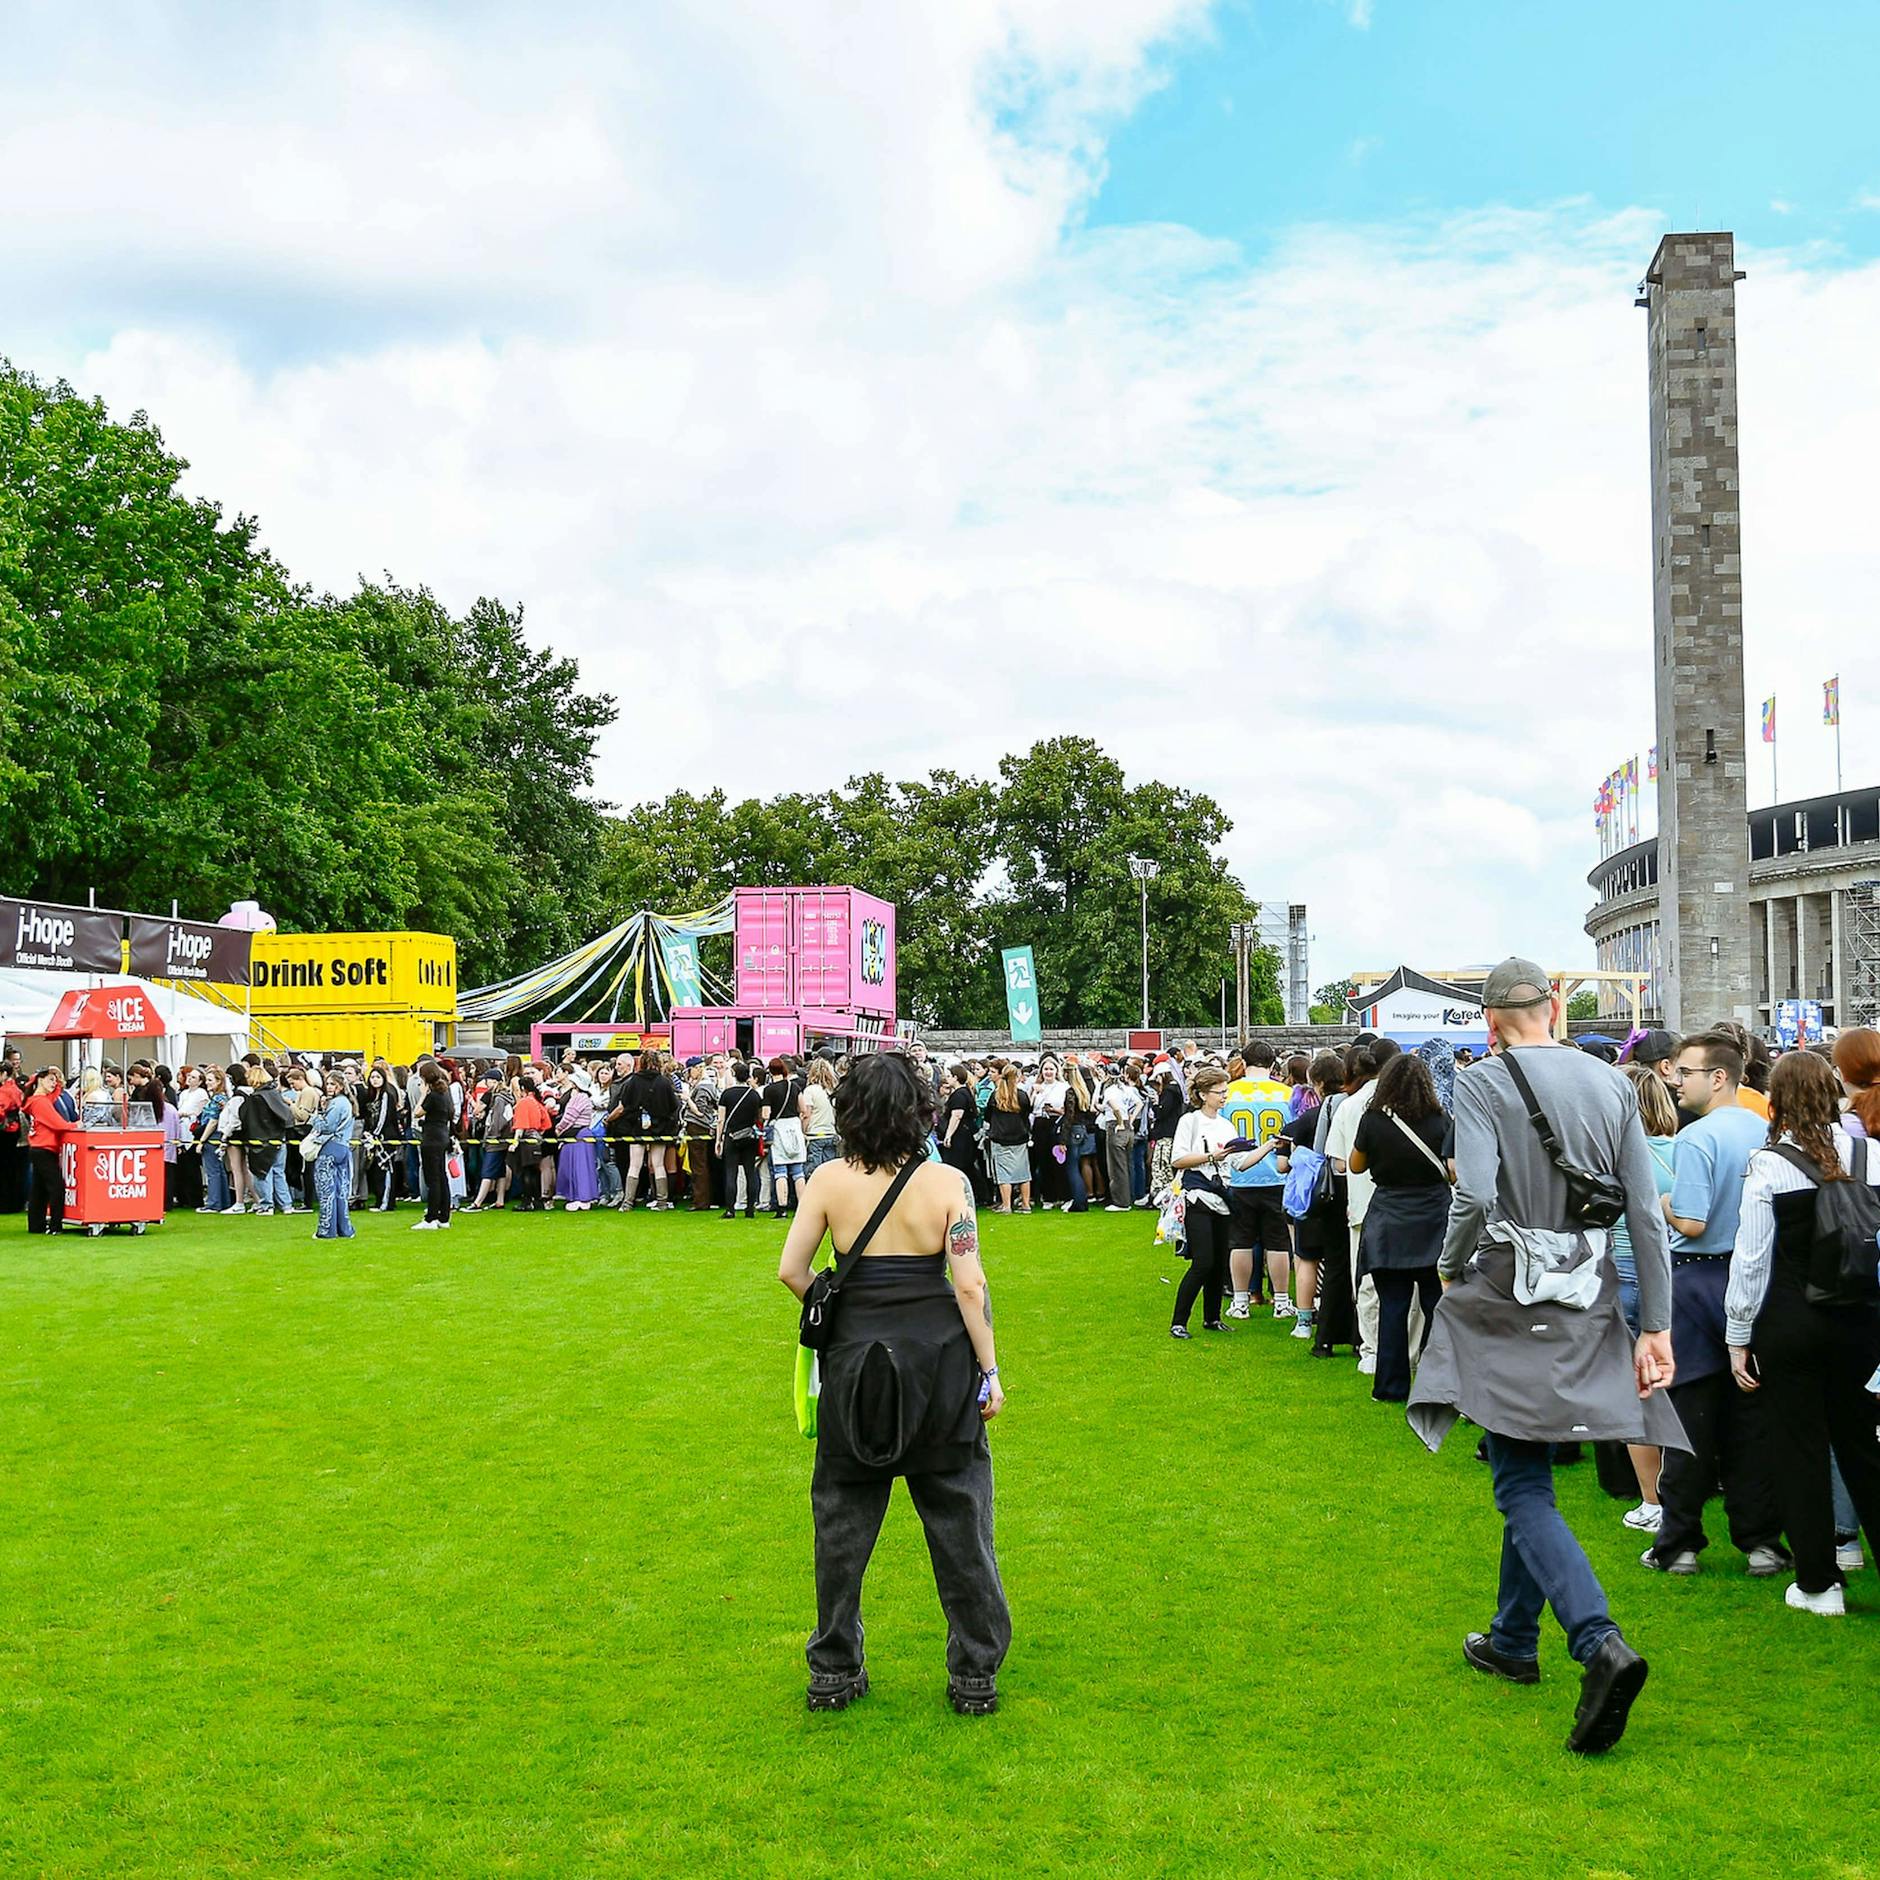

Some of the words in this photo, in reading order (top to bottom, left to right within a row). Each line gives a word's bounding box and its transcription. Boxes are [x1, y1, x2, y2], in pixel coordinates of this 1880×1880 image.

[15, 907, 75, 954] j-hope
[167, 925, 213, 966] j-hope
[252, 959, 323, 987] Drink
[331, 958, 387, 986] Soft
[116, 997, 145, 1022] ICE
[1393, 1012, 1421, 1021] Imagine
[1443, 1008, 1482, 1025] Korea
[117, 1021, 146, 1033] CREAM
[1230, 1109, 1284, 1146] 08
[109, 1150, 148, 1184] ICE
[108, 1184, 147, 1199] CREAM
